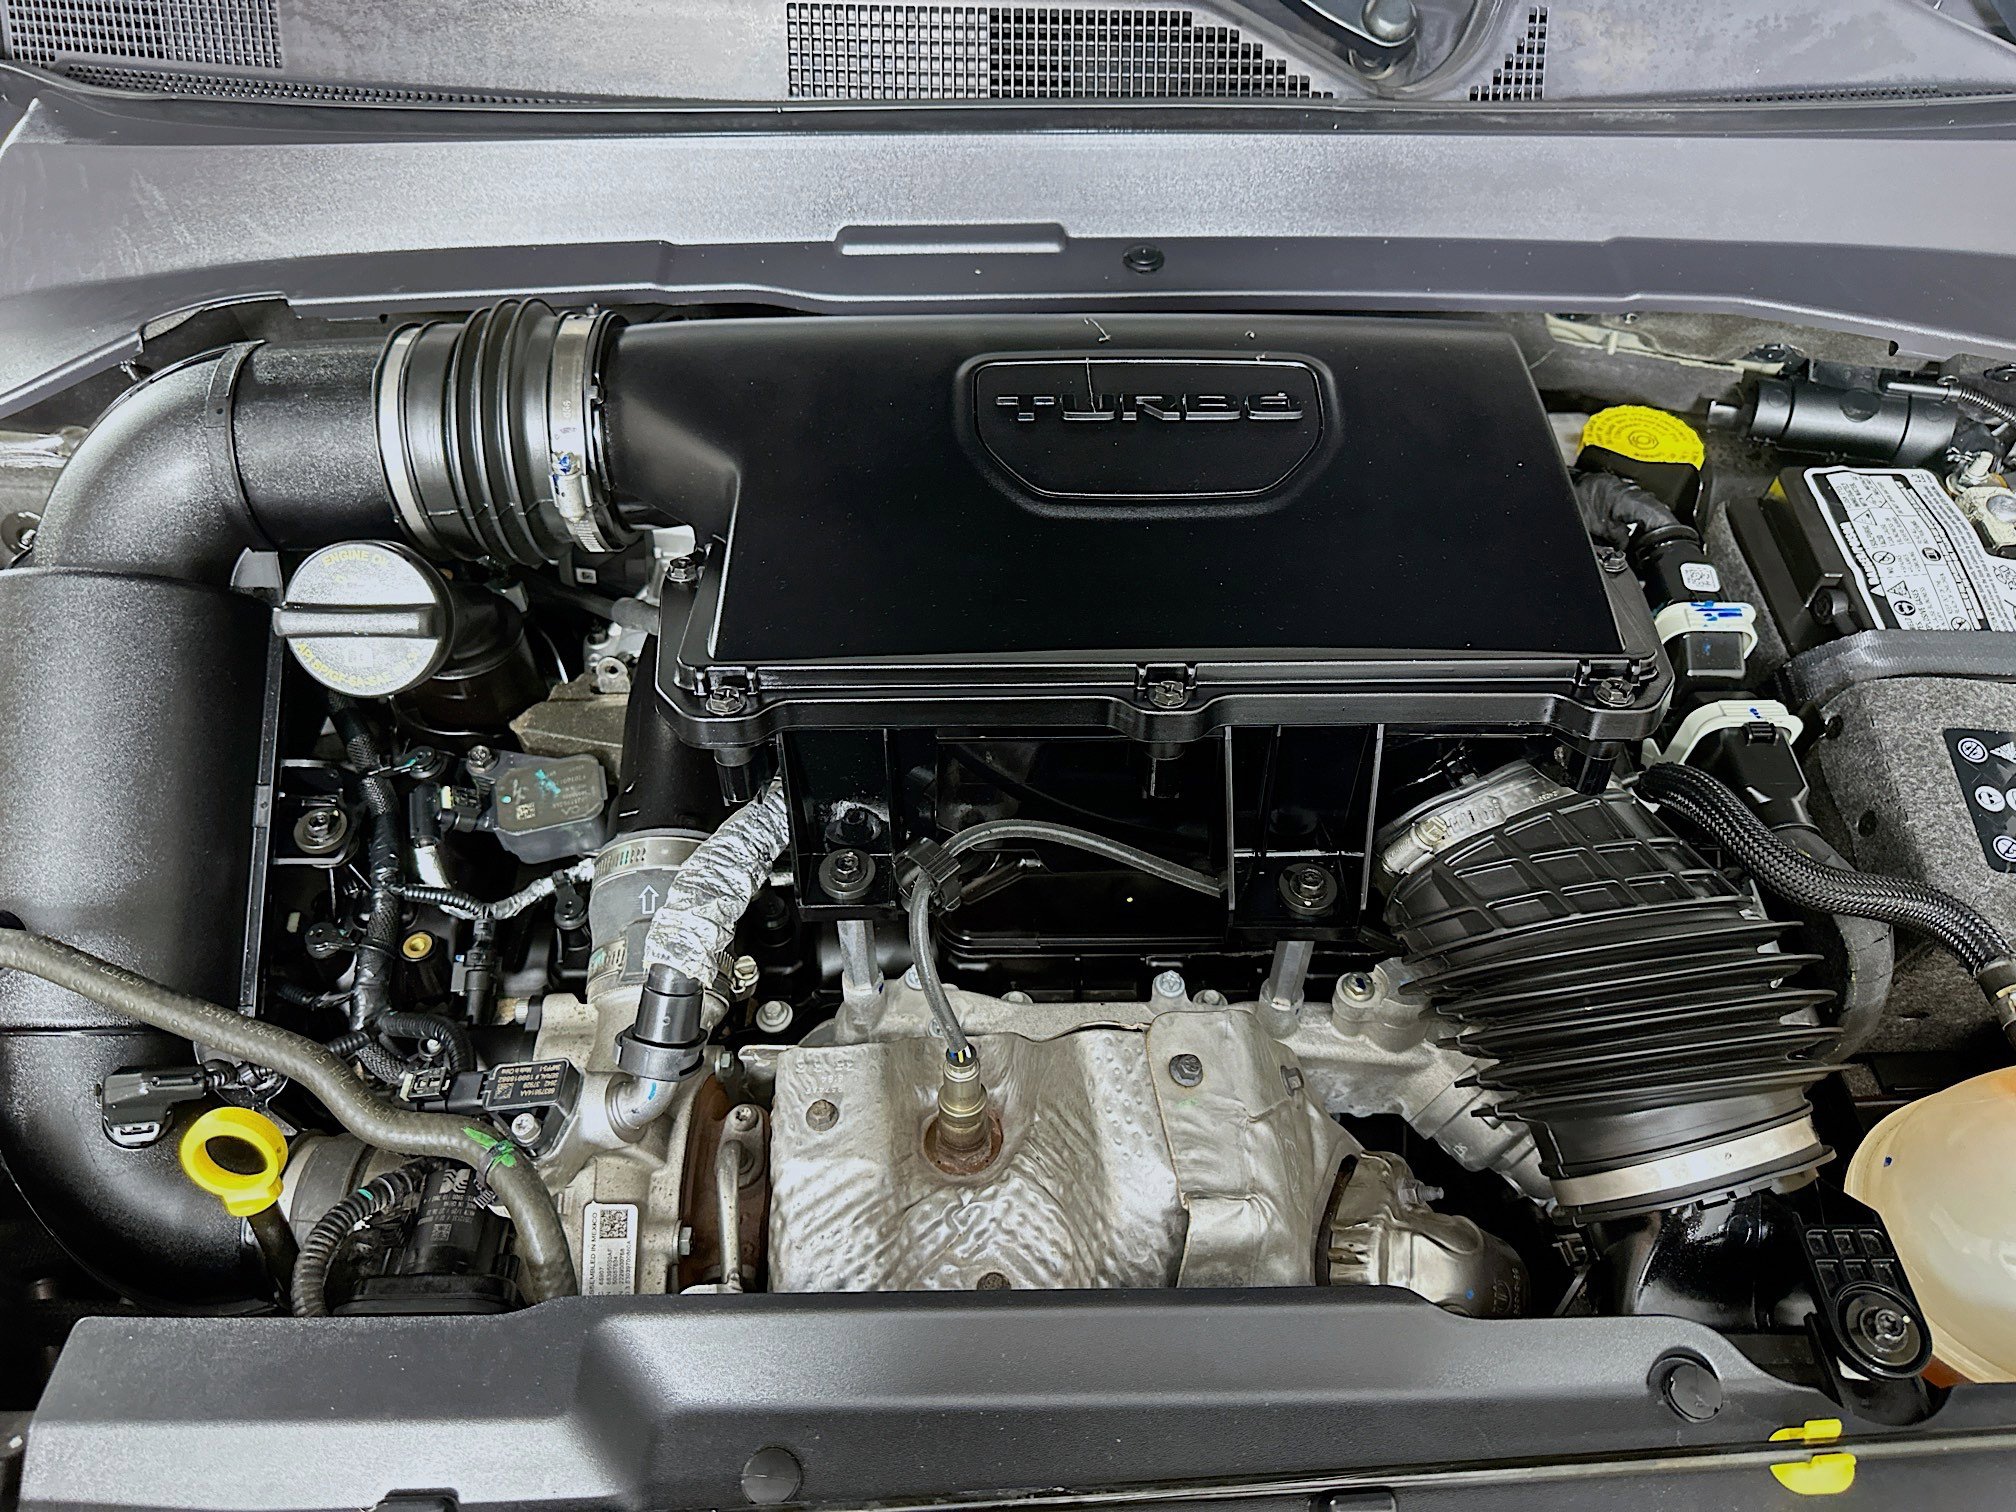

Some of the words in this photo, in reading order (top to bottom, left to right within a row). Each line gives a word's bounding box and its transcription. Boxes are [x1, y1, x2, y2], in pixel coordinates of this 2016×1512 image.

[995, 392, 1303, 422] TURBO
[322, 549, 369, 567] ENGINE
[589, 1254, 597, 1294] SSEMBLED
